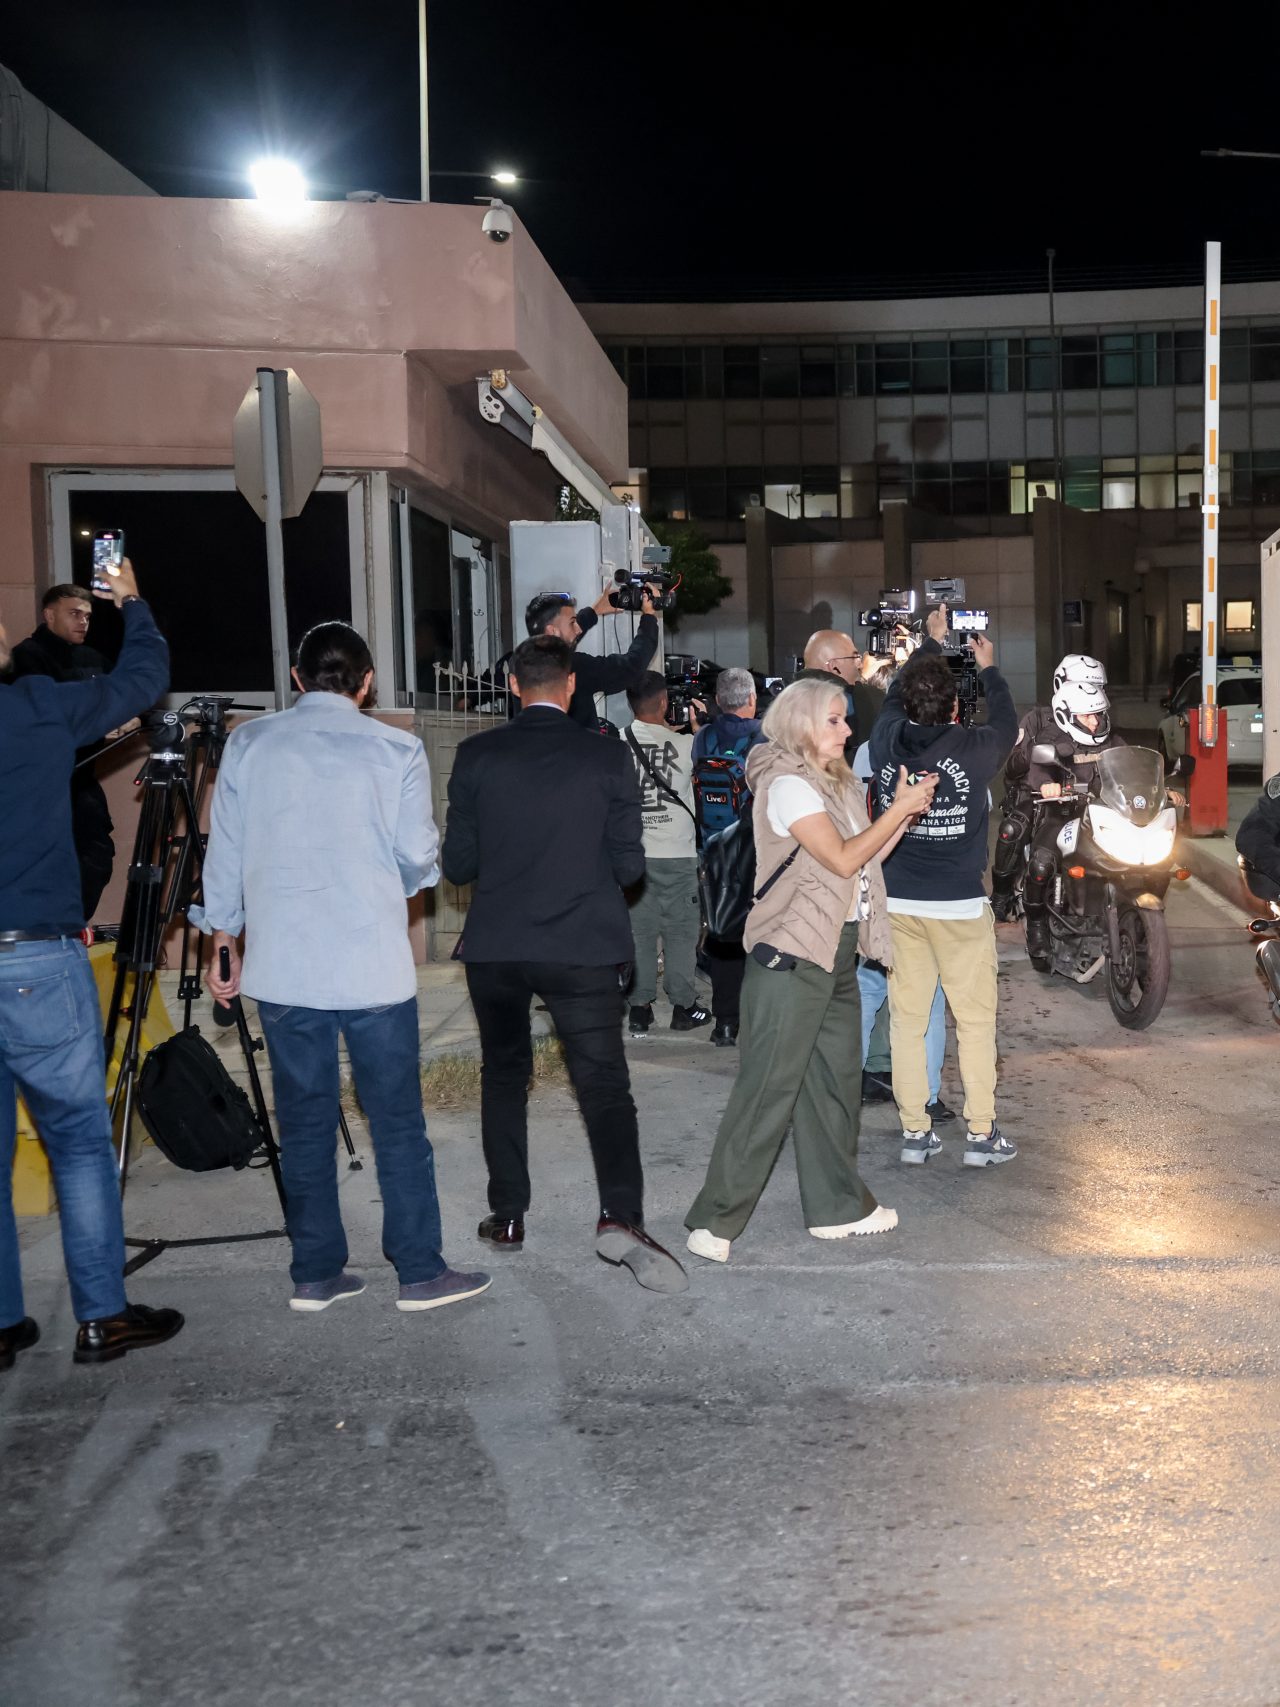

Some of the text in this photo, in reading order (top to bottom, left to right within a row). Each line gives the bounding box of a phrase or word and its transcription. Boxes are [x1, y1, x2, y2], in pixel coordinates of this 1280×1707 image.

[937, 757, 970, 793] LEGACY
[706, 794, 727, 803] LiveU
[928, 804, 969, 817] aradise
